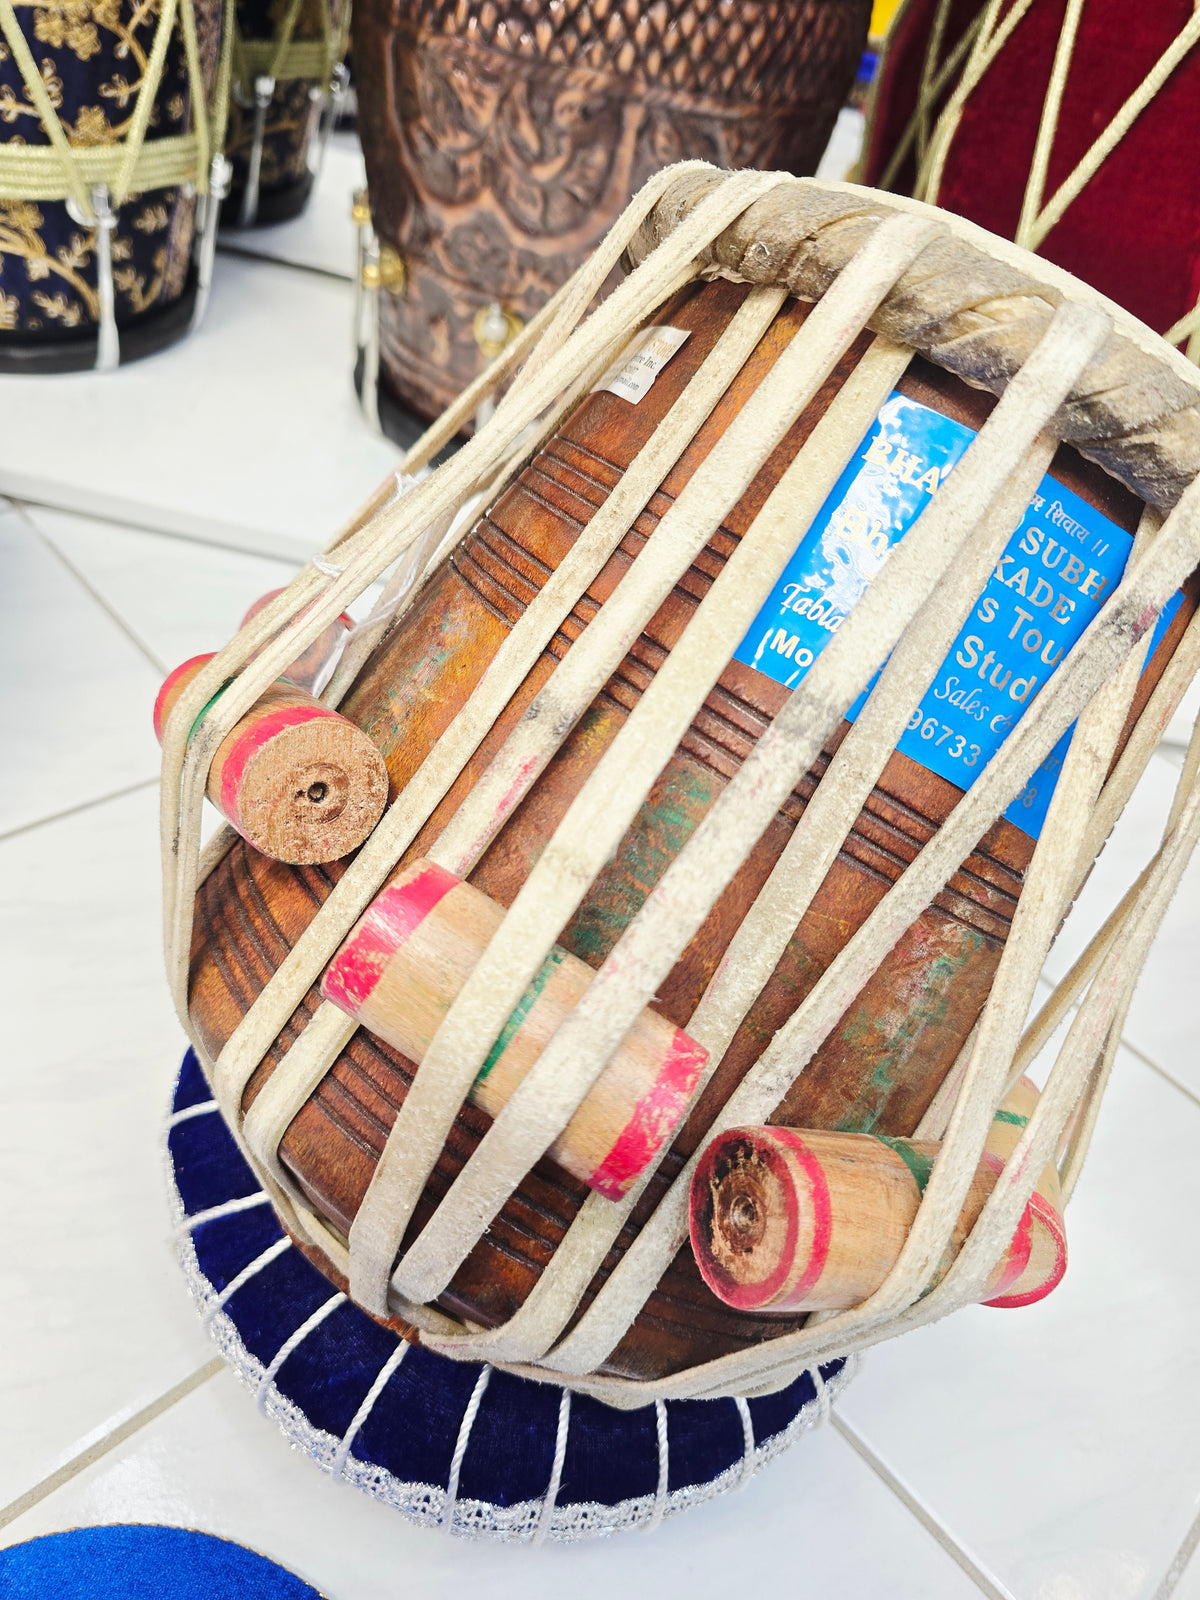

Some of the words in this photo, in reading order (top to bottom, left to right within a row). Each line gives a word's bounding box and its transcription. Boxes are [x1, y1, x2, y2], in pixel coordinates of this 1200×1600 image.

[834, 506, 900, 559] Bh
[1045, 500, 1090, 544] शिवाय
[1018, 526, 1112, 605] SUBH
[780, 582, 847, 634] Tabla
[933, 676, 990, 721] Sales
[955, 634, 1042, 705] Stud
